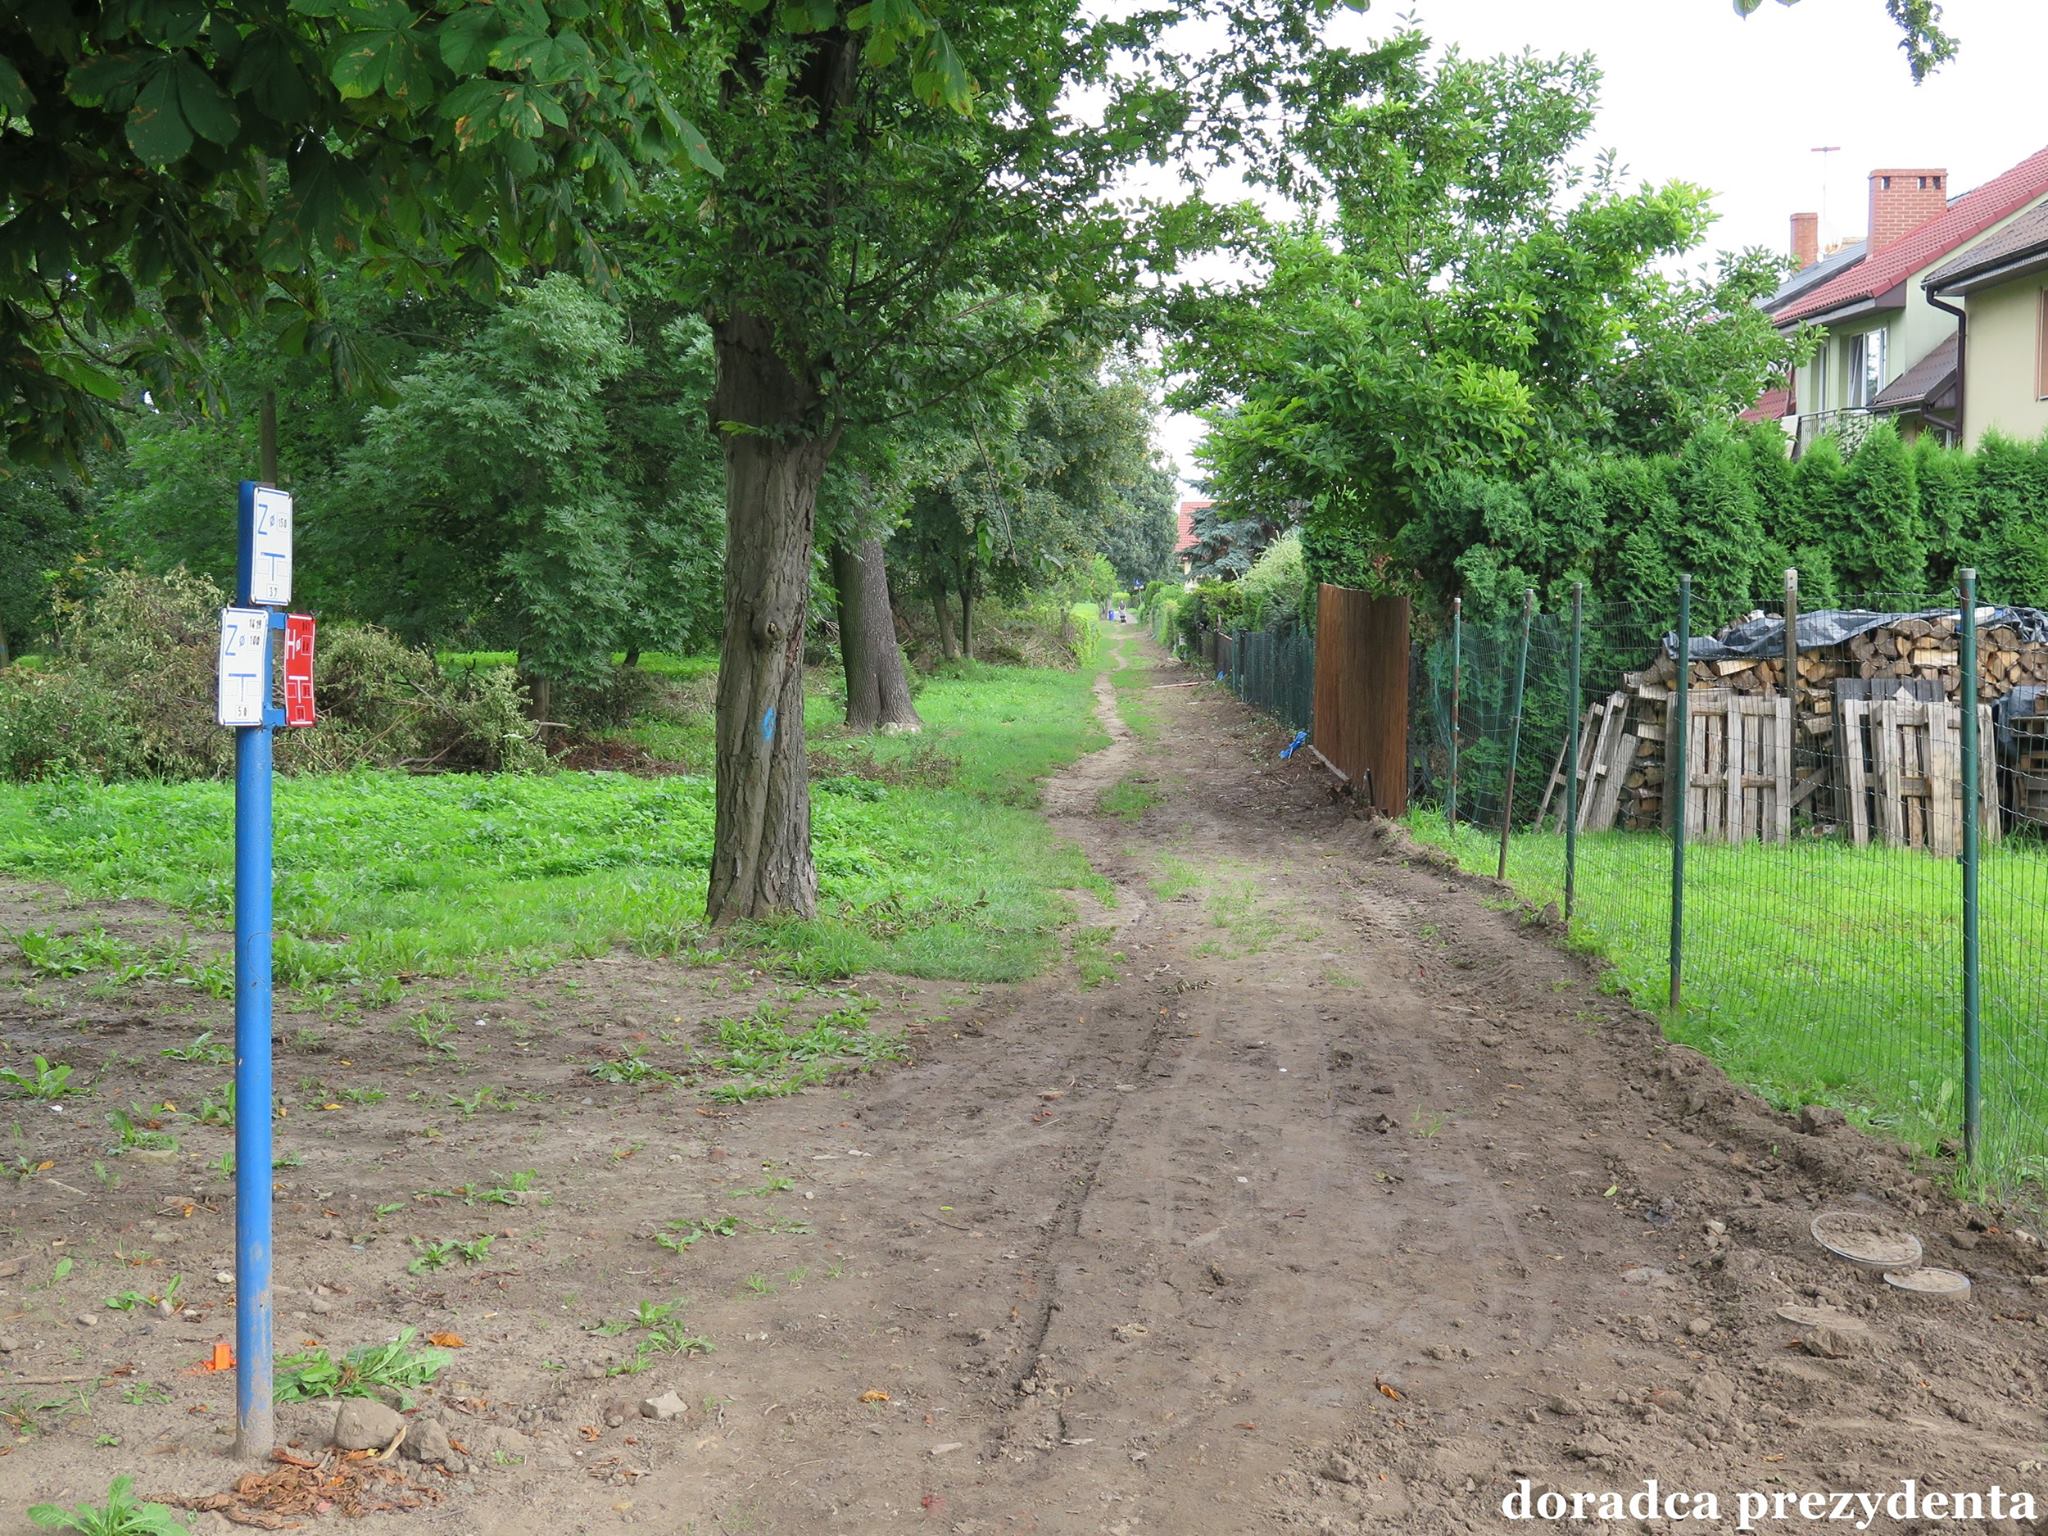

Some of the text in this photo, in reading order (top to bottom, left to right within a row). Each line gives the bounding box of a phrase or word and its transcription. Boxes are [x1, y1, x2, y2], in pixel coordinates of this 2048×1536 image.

[258, 504, 268, 535] Z
[225, 624, 238, 656] Z
[286, 629, 296, 660] H
